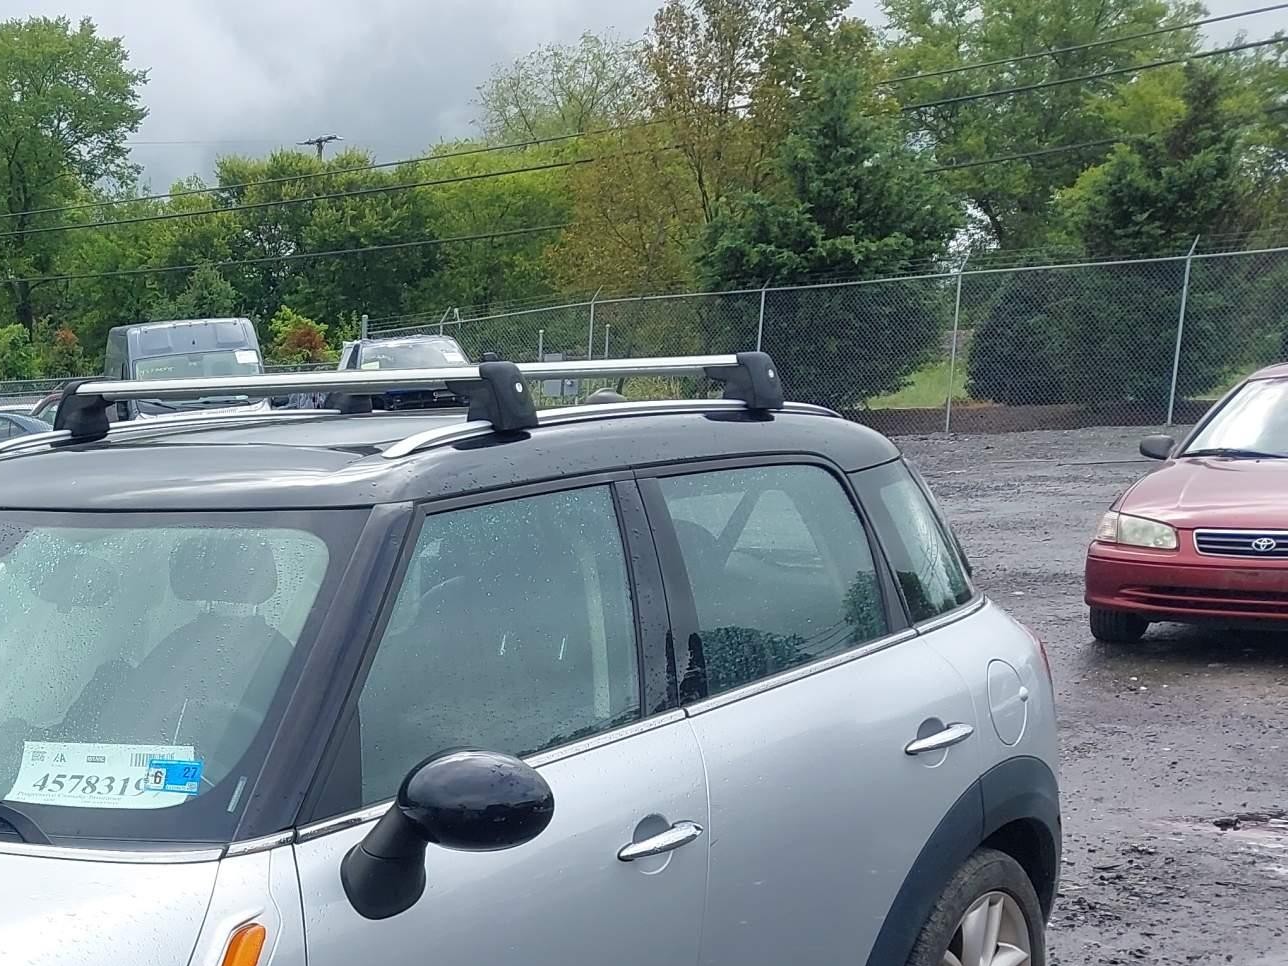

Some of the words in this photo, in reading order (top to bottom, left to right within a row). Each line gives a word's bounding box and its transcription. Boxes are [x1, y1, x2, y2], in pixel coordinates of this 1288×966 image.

[32, 772, 160, 798] 4578319
[154, 770, 163, 785] 6
[183, 766, 198, 779] 27
